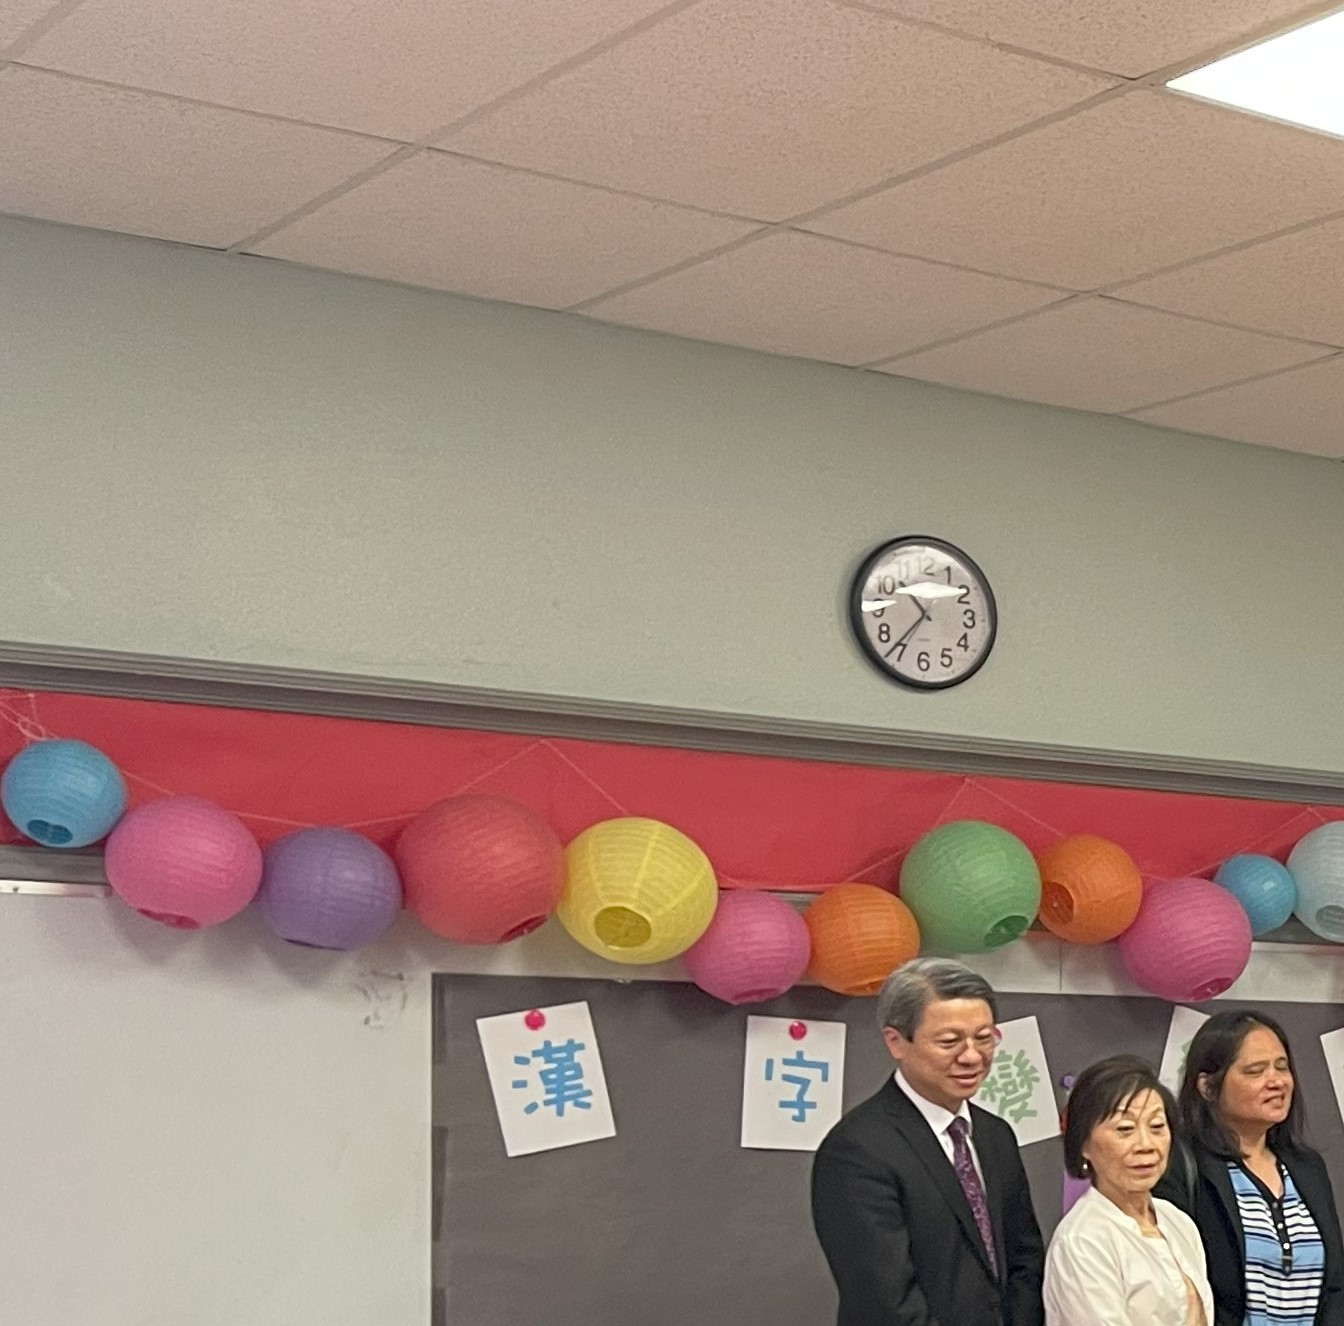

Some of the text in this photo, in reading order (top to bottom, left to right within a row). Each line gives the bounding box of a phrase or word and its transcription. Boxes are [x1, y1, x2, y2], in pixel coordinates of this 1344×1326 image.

[917, 556, 935, 576] 12
[945, 566, 951, 584] 1
[877, 575, 895, 595] 10
[957, 585, 970, 604] 2
[962, 609, 976, 629] 3
[877, 623, 890, 643] 8
[957, 632, 969, 652] 4
[917, 652, 930, 671] 6
[940, 648, 953, 668] 5
